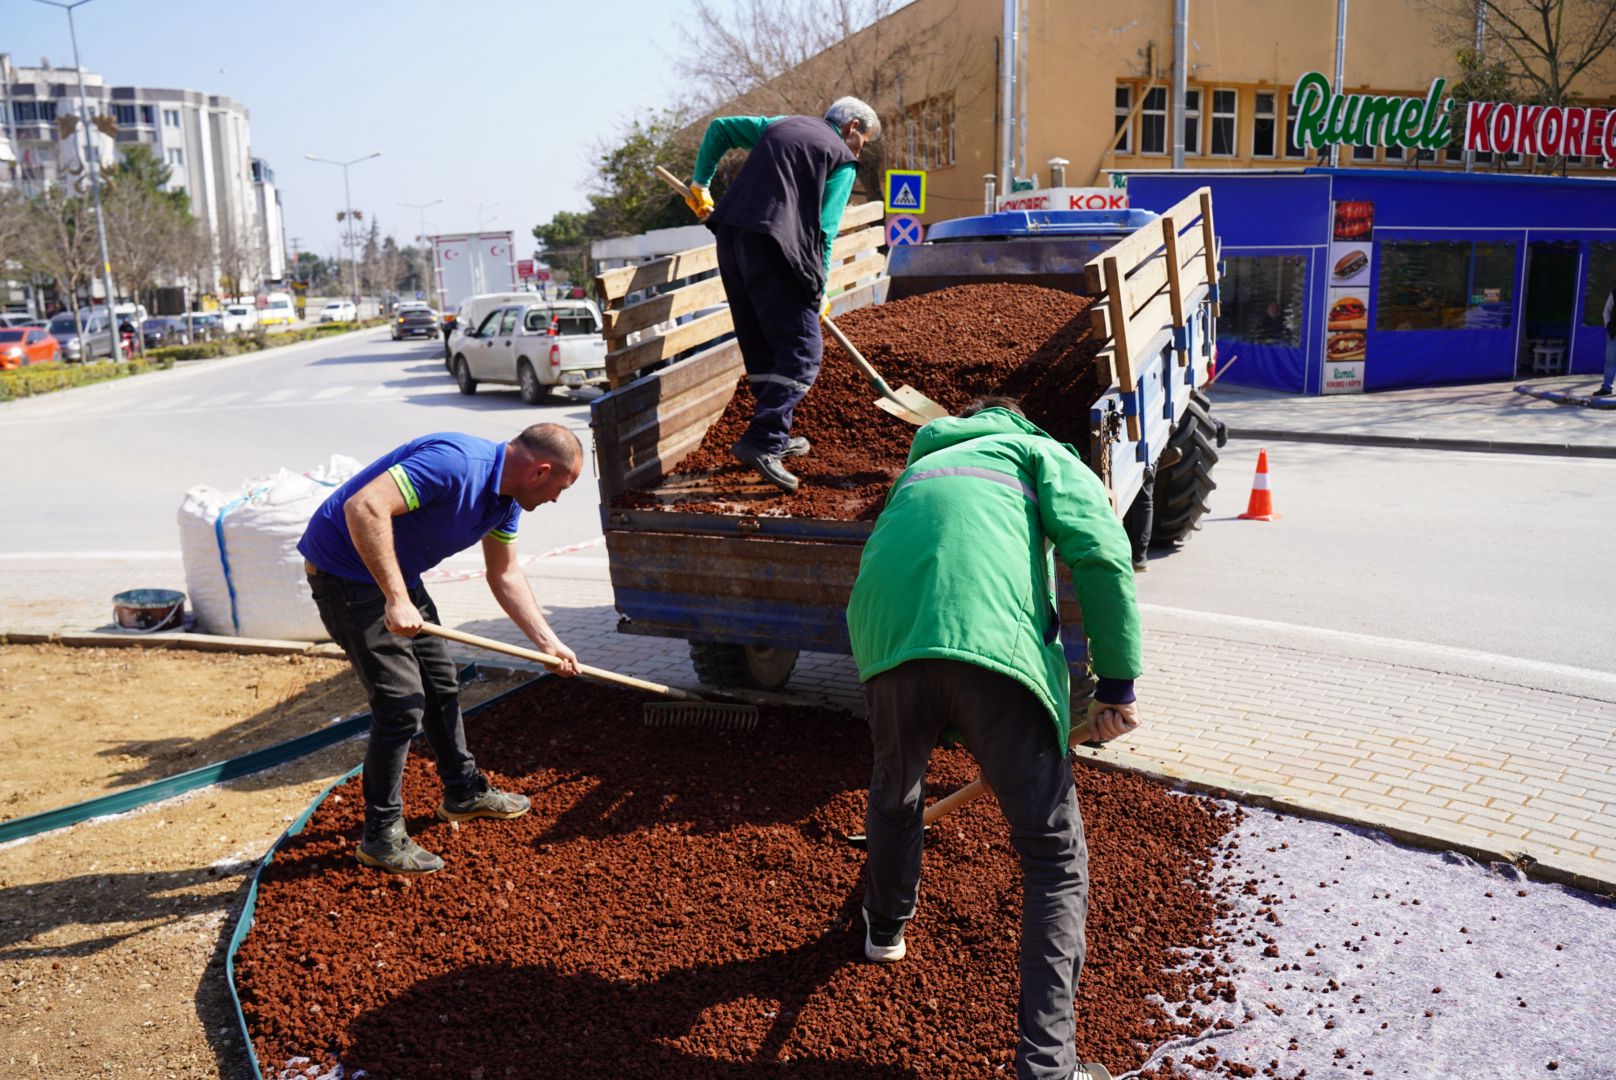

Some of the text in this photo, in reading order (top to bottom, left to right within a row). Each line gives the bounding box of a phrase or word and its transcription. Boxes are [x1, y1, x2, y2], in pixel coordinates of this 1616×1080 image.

[1293, 71, 1616, 168] Rumeli KOKOREÇ
[1069, 194, 1129, 209] KOK
